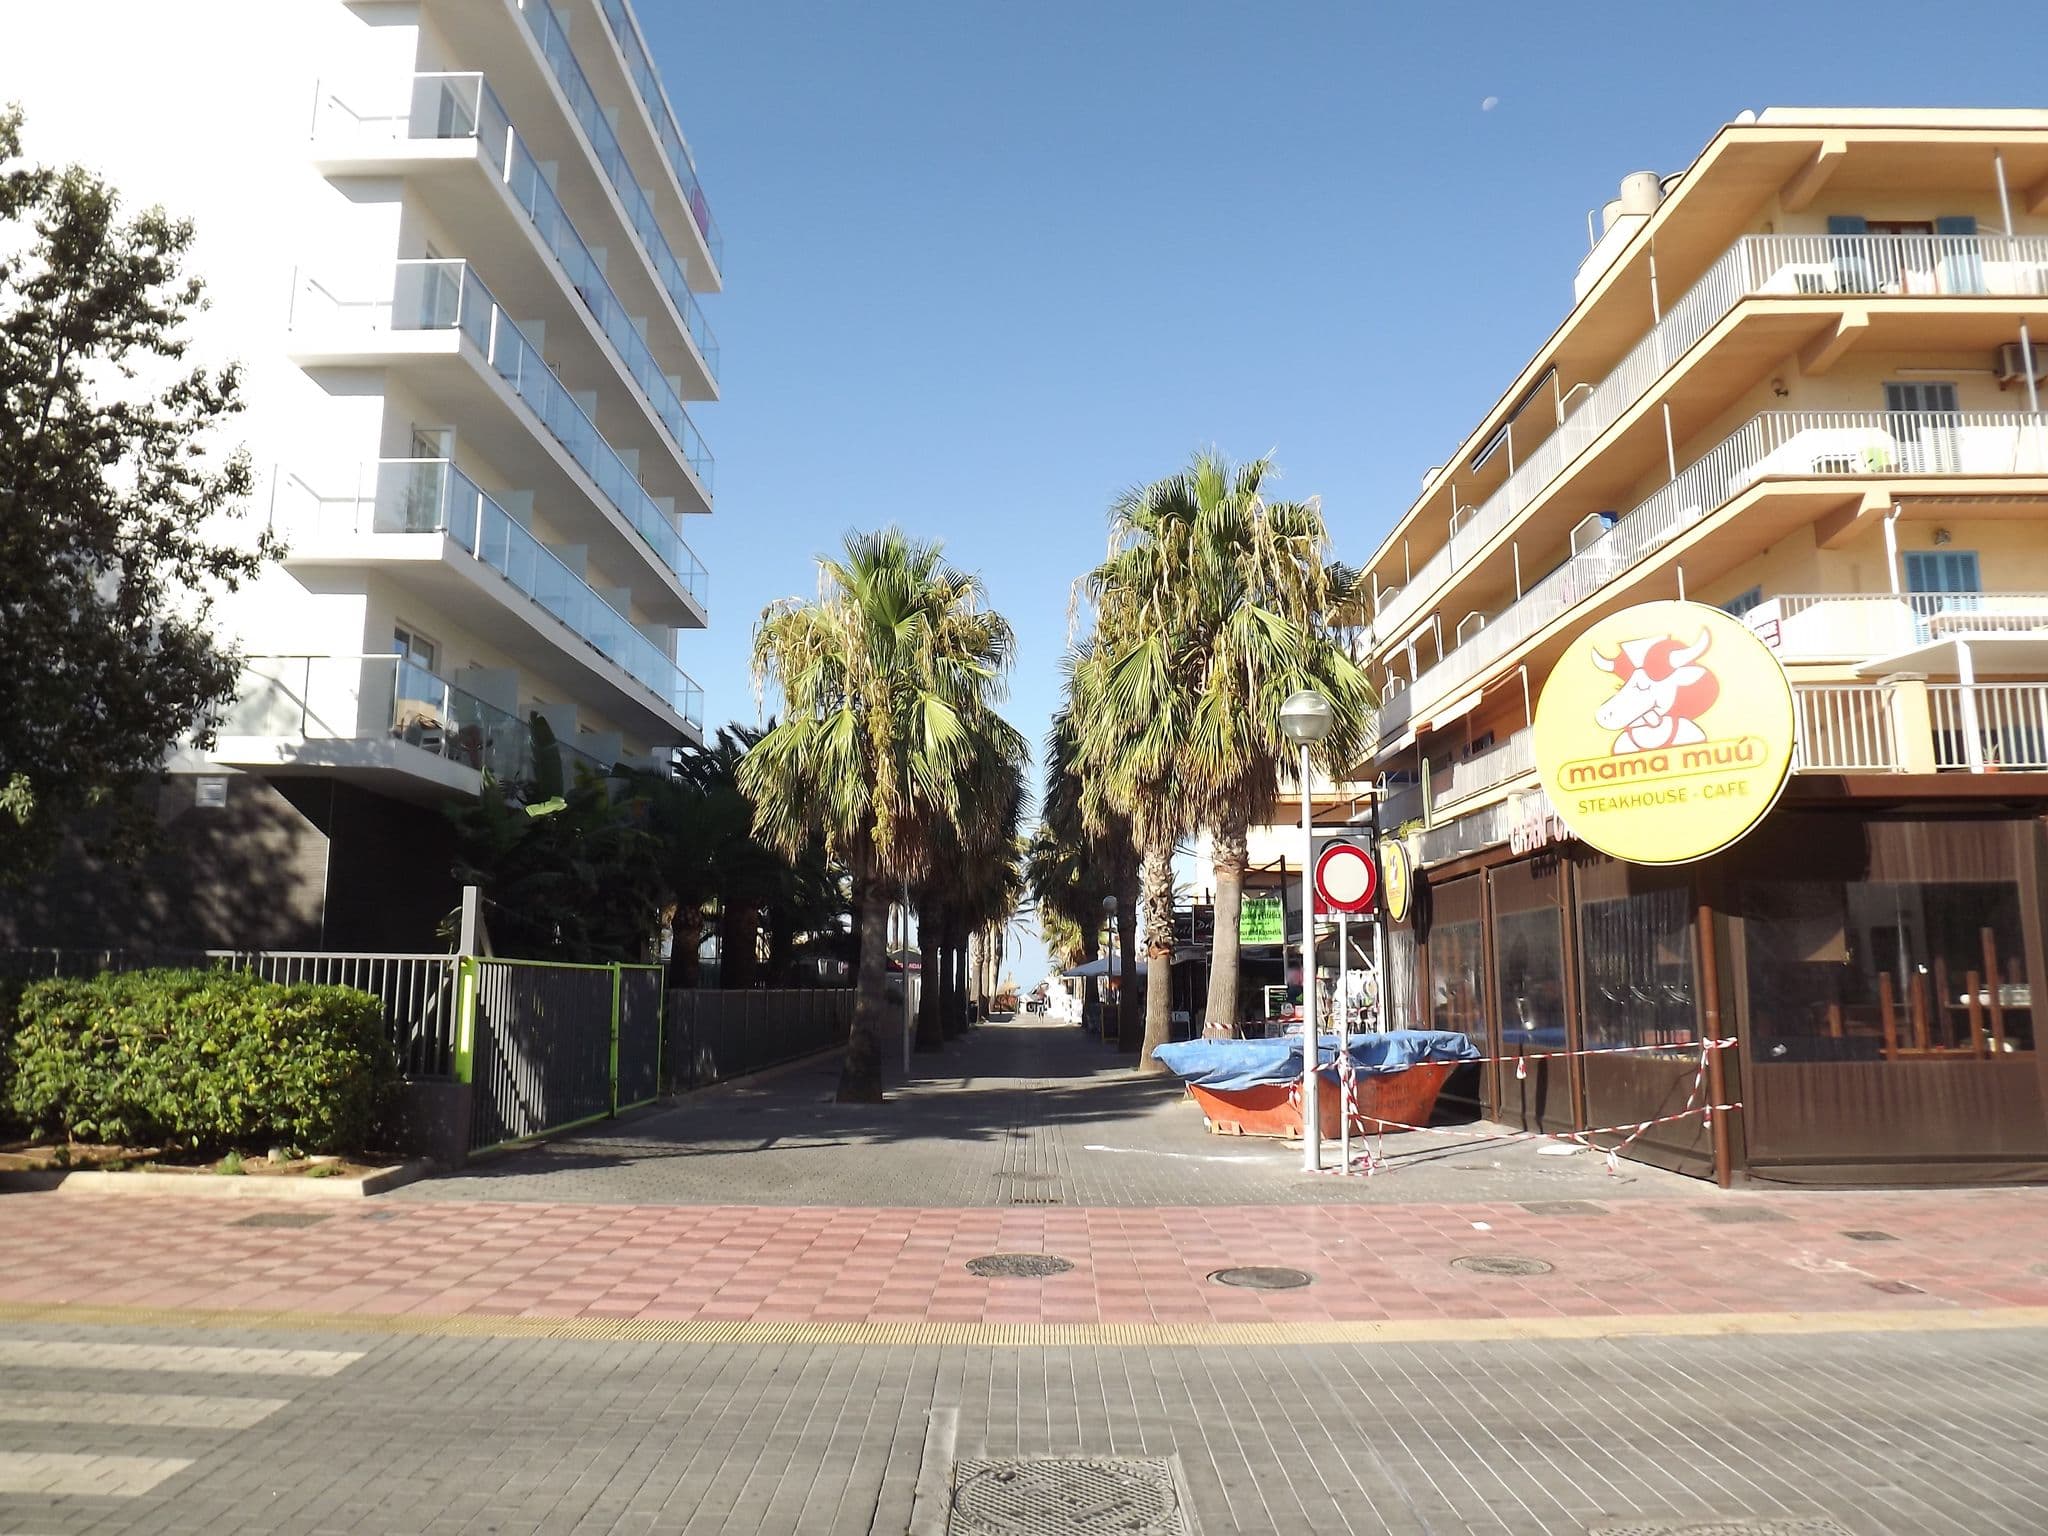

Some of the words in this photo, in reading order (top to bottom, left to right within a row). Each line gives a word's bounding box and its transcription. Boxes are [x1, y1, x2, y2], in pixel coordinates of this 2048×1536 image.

[1569, 755, 1669, 784] mama
[1682, 736, 1753, 769] muú
[1578, 787, 1688, 815] STEAKHOUSE
[1509, 812, 1547, 855] GRAN
